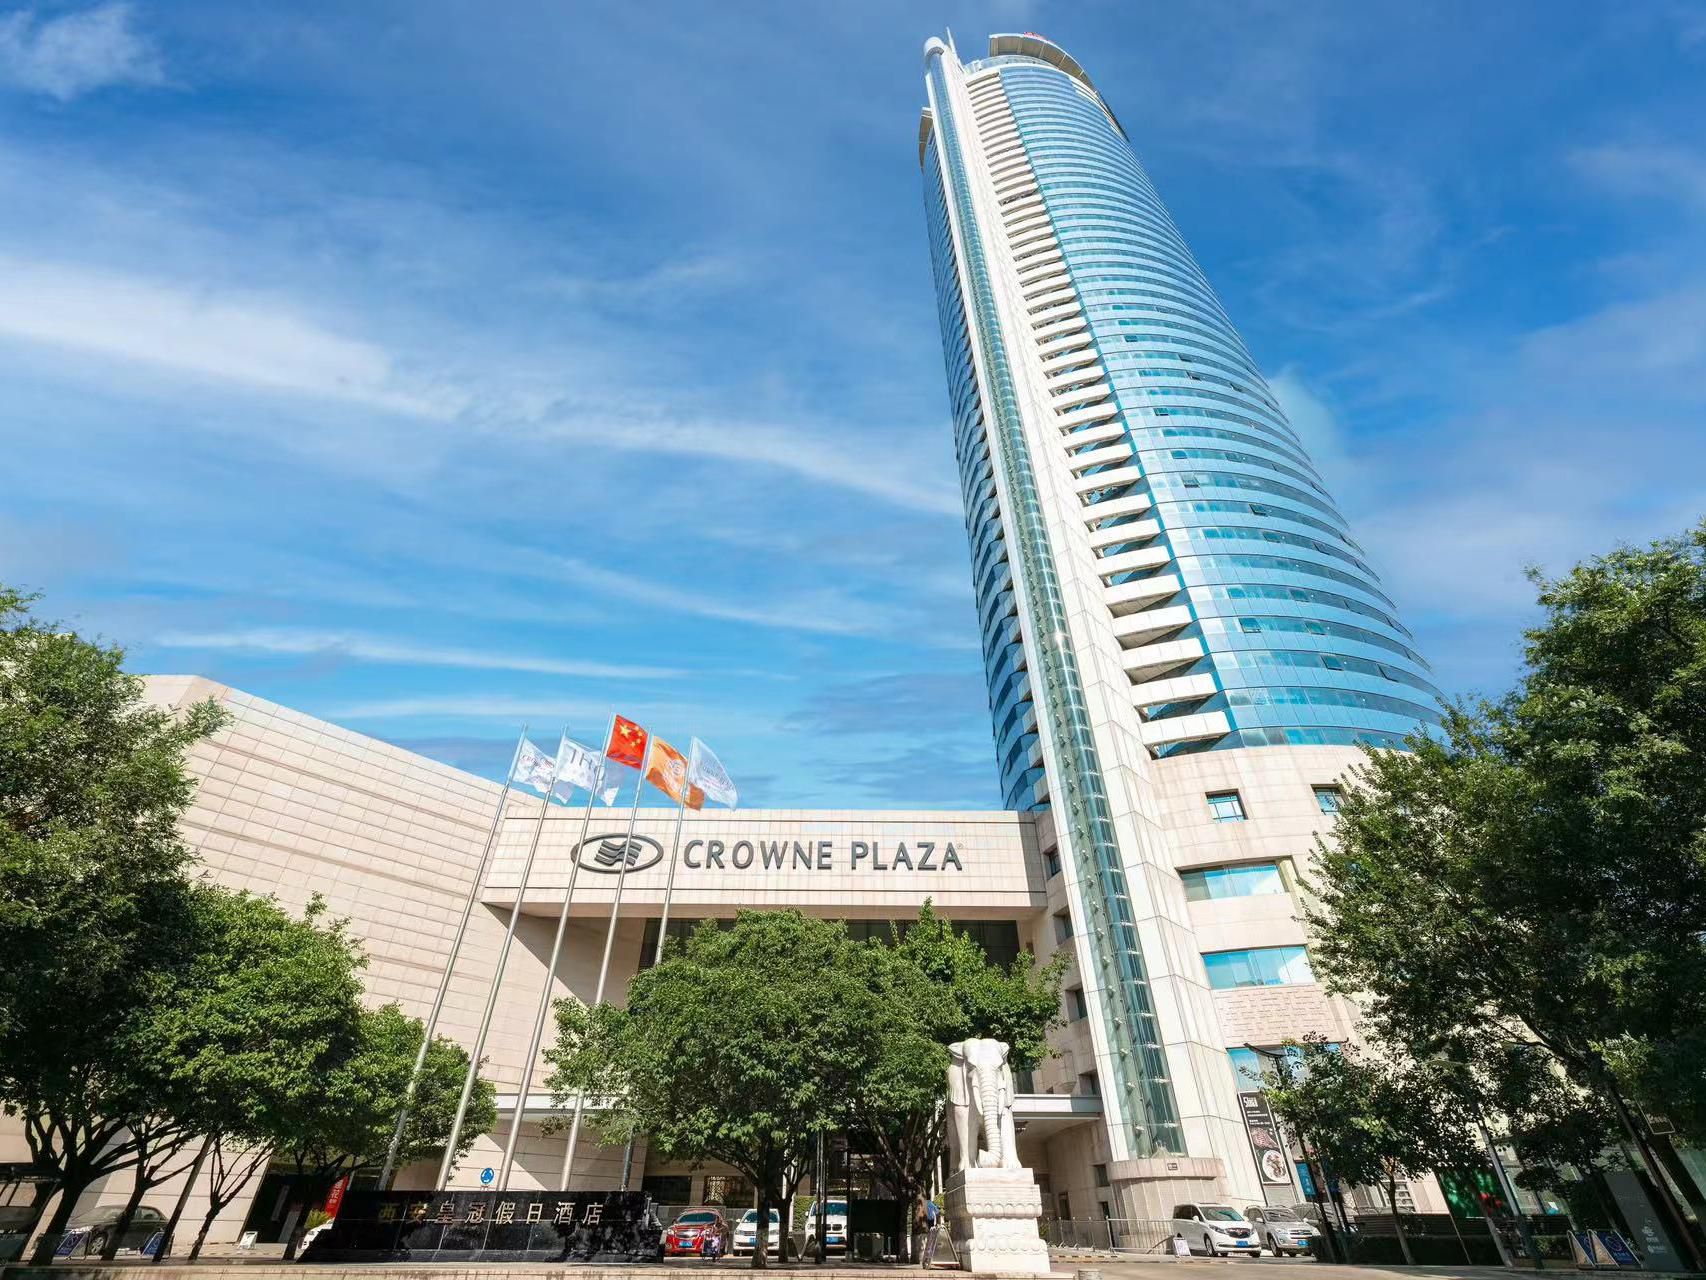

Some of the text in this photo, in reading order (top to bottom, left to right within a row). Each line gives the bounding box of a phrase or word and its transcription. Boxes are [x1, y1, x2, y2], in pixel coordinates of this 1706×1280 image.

[683, 839, 963, 871] CROWNE PLAZA
[378, 1200, 604, 1226] 西安皇冠假日酒店
